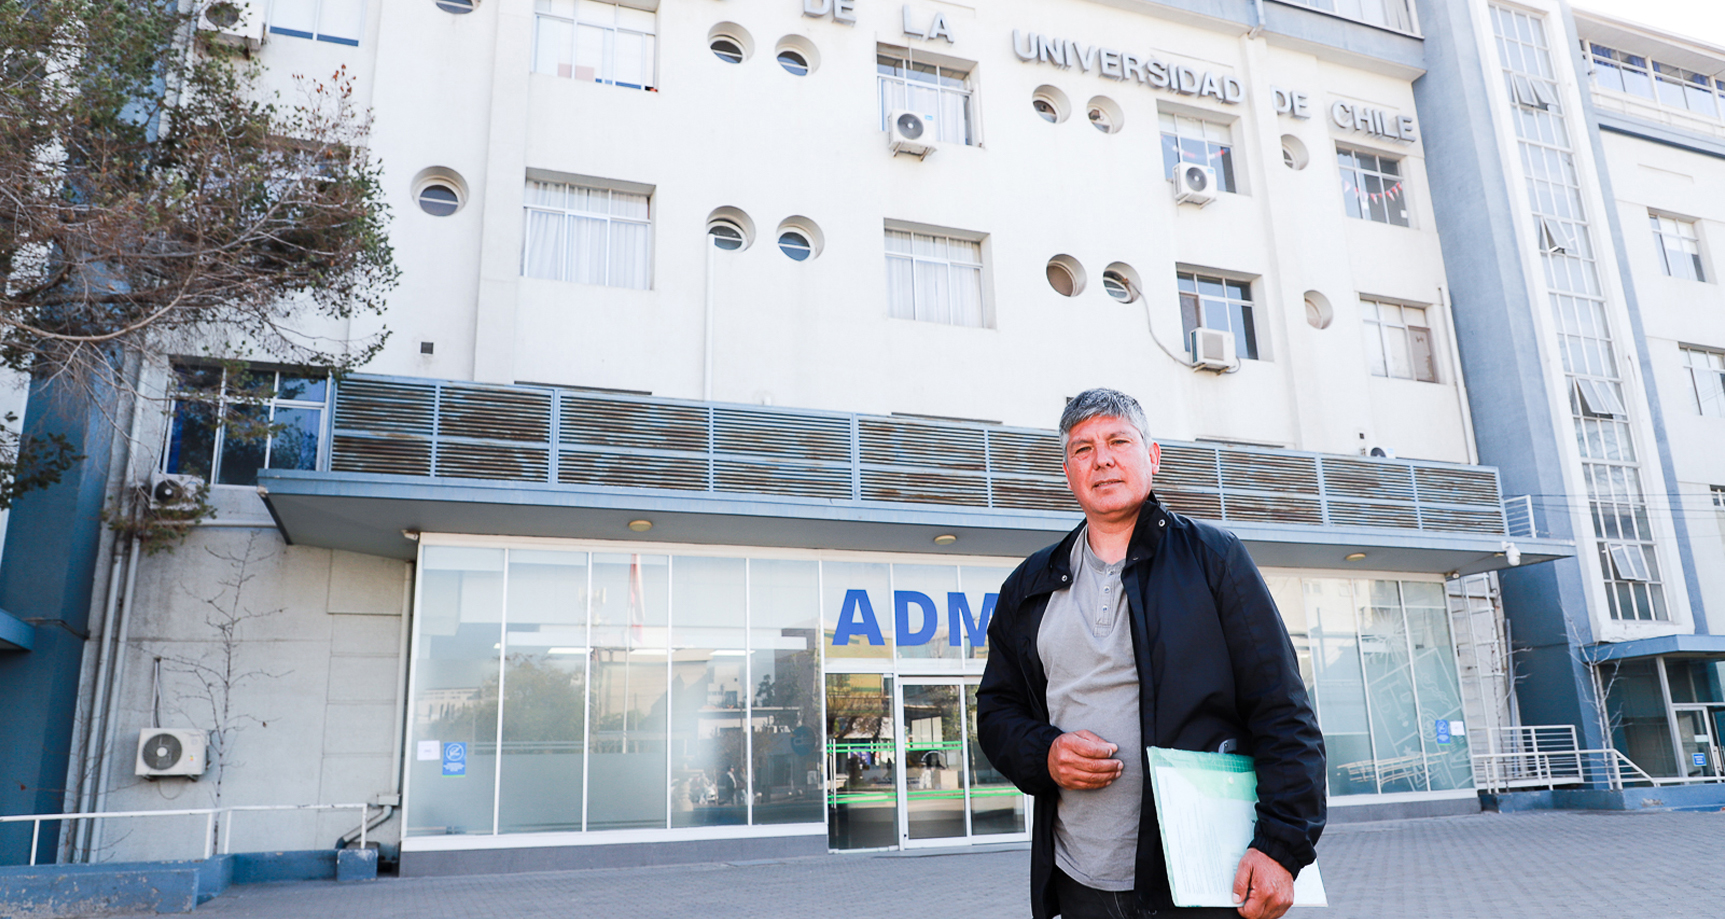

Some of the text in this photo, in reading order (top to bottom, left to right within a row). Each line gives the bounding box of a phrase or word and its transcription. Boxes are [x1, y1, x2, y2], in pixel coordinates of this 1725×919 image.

[902, 4, 954, 43] LA
[1012, 29, 1245, 104] UNIVERSIDAD
[1271, 84, 1311, 119] DE
[1331, 100, 1417, 143] CHILE
